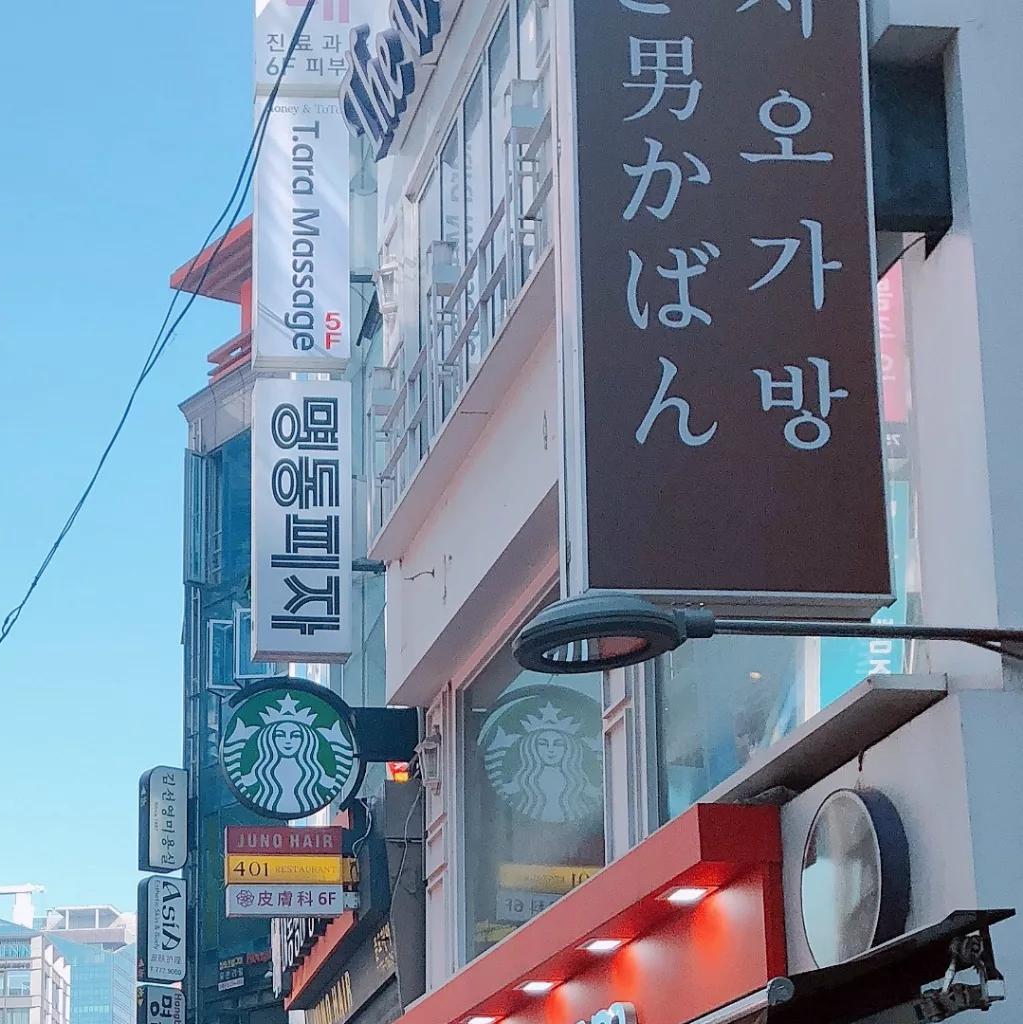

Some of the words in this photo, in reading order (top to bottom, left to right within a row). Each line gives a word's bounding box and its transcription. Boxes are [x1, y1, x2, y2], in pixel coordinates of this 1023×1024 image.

[291, 119, 320, 195] T.ara
[284, 208, 321, 351] Massage
[271, 396, 341, 636] 명동피자
[161, 773, 176, 866] 김선영미용실
[289, 833, 334, 849] HAIR
[233, 861, 269, 878] 401
[275, 865, 337, 874] RESTAURANT
[257, 890, 314, 907] 皮膚科
[318, 891, 337, 906] 6F
